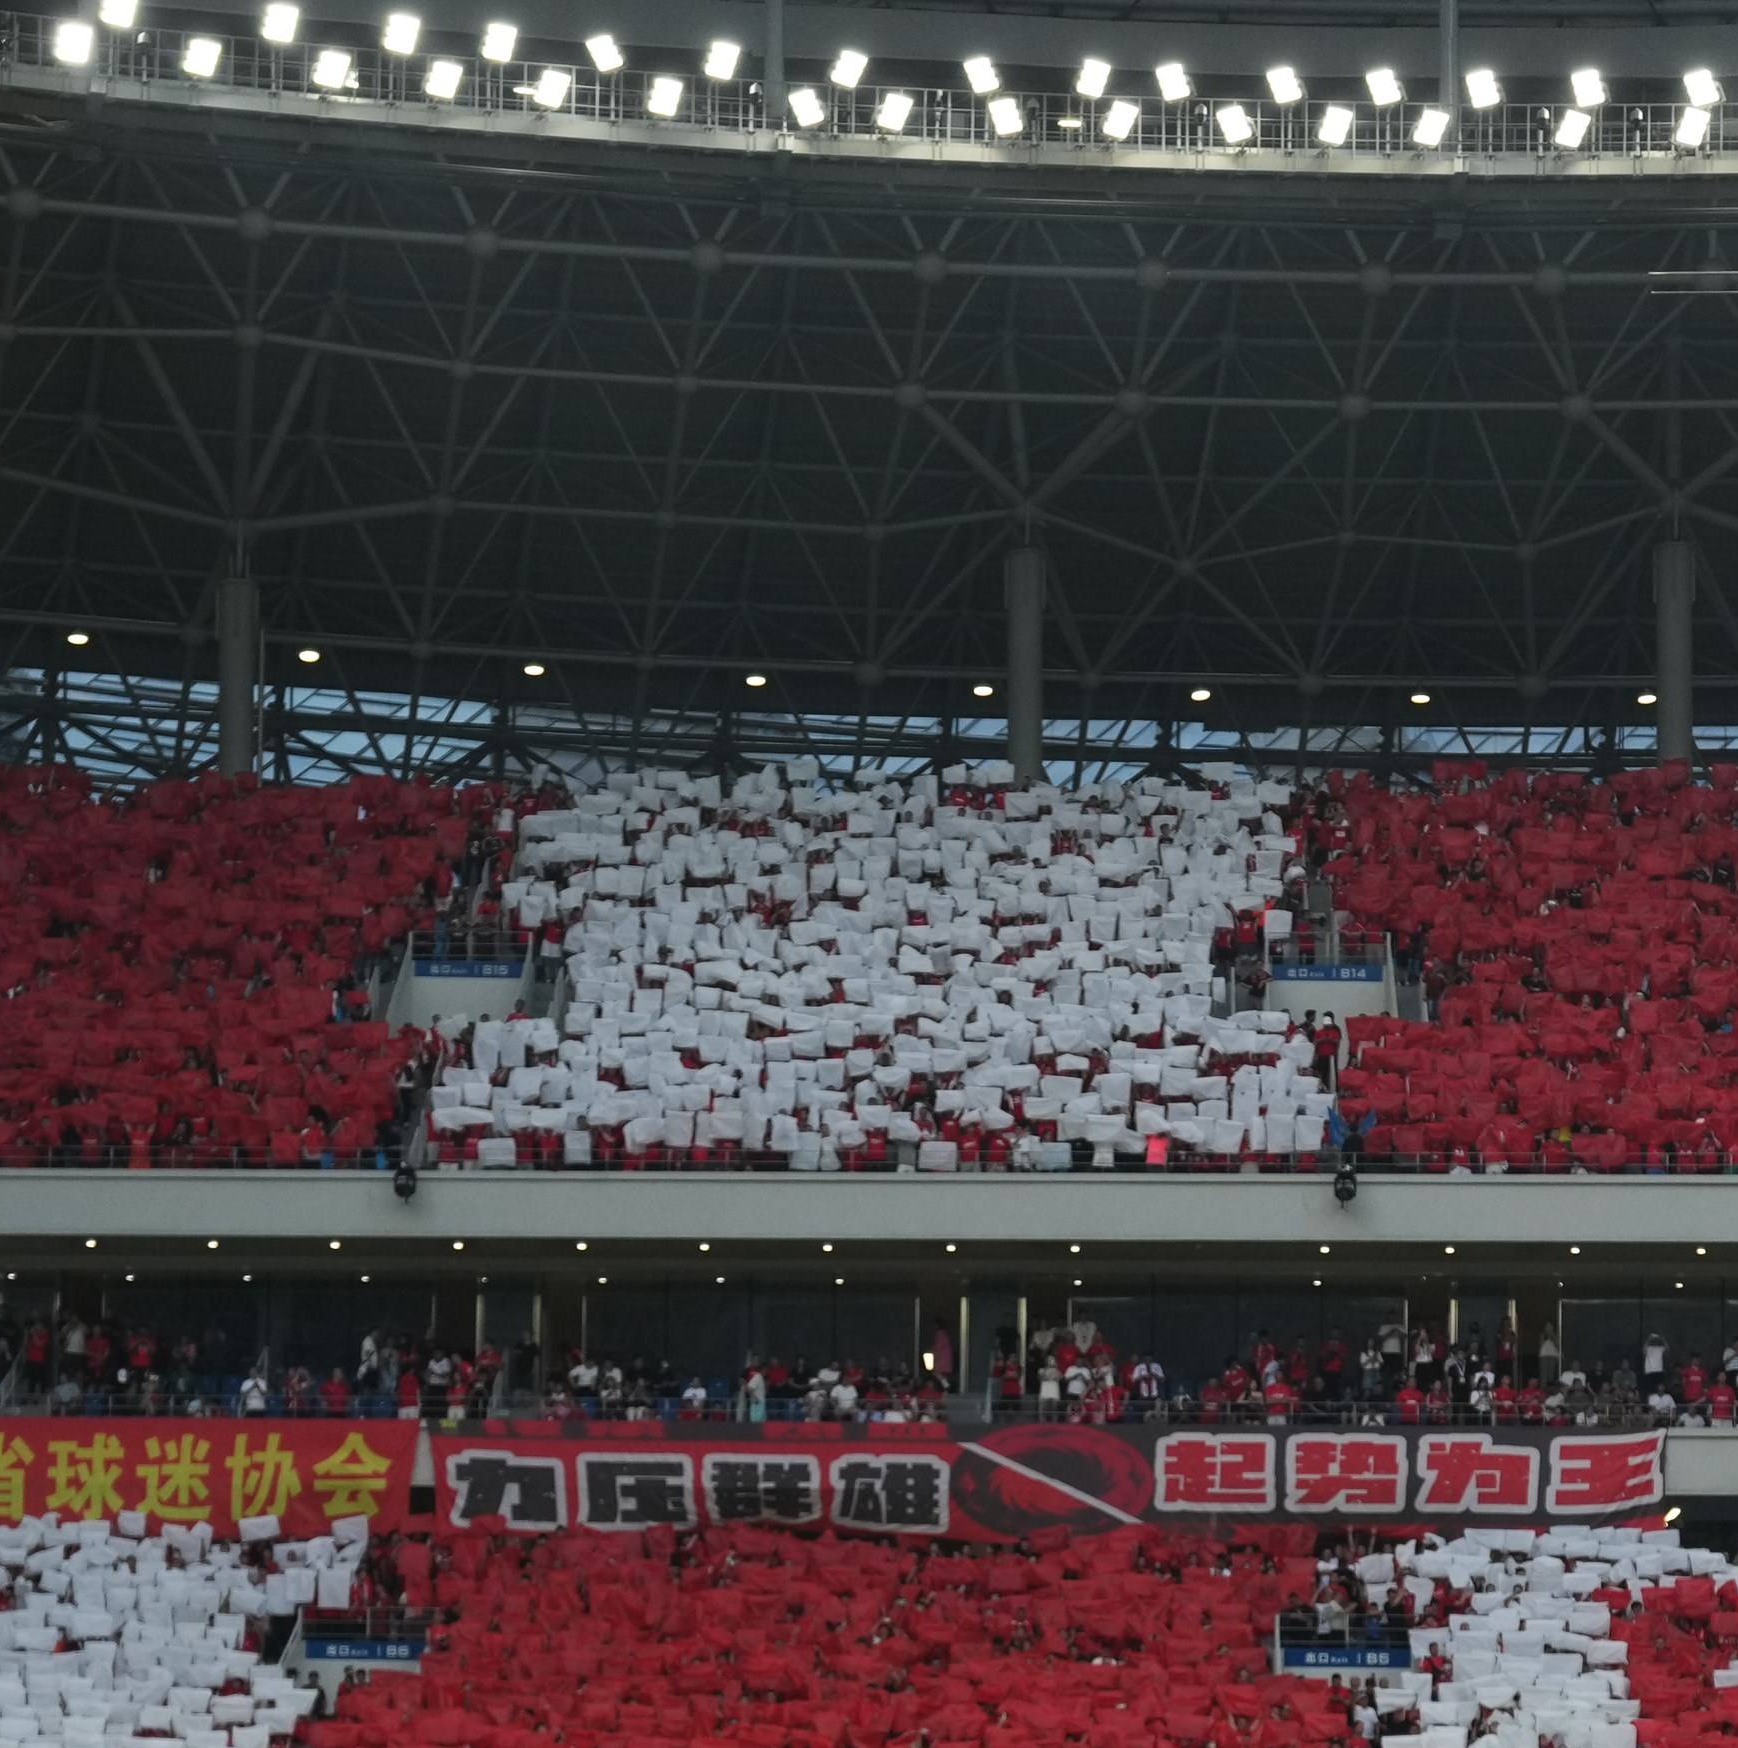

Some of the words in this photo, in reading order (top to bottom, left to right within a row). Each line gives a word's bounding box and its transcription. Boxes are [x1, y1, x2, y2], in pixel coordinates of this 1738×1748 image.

[1340, 967, 1367, 978] B14
[1155, 1430, 1664, 1514] 起势为王
